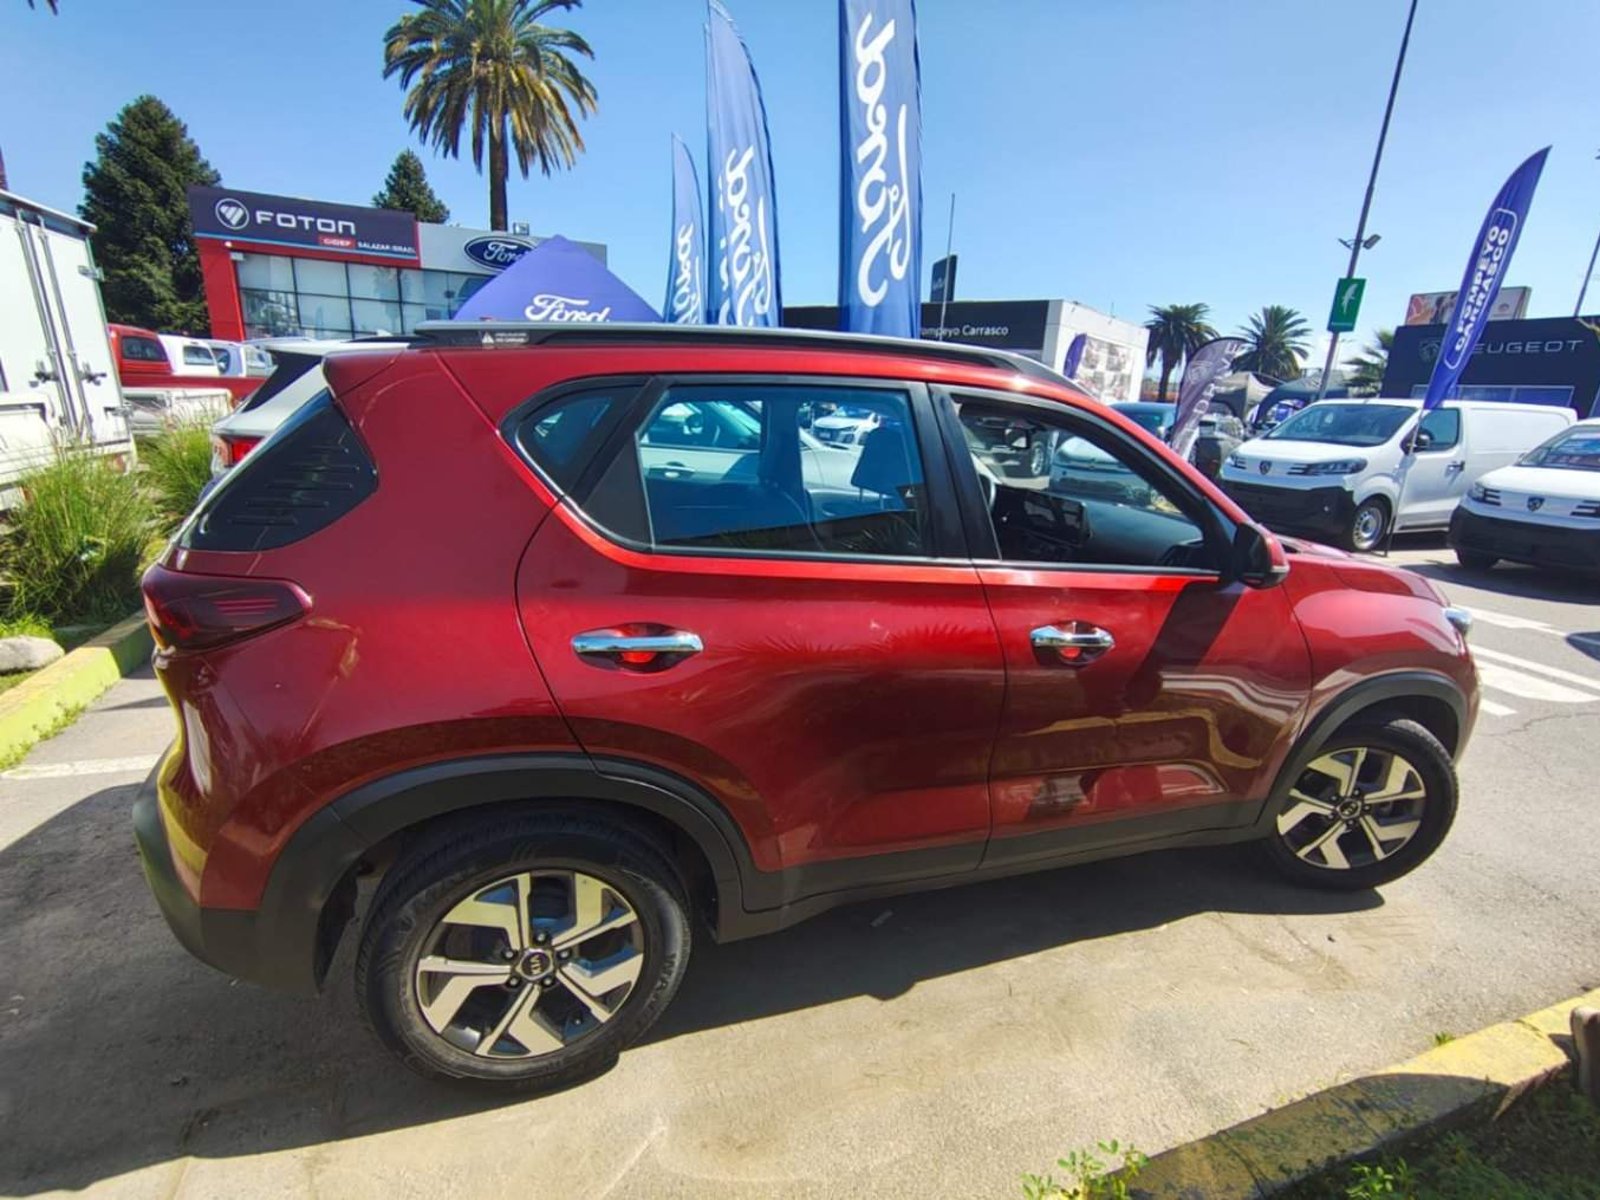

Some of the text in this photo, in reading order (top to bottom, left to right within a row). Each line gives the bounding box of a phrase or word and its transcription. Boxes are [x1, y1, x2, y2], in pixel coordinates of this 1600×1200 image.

[255, 210, 356, 235] FOTON
[483, 240, 524, 263] For
[524, 293, 611, 322] Ford
[921, 324, 1009, 337] ompeyo Carrasco
[1471, 339, 1584, 355] EUGEOT
